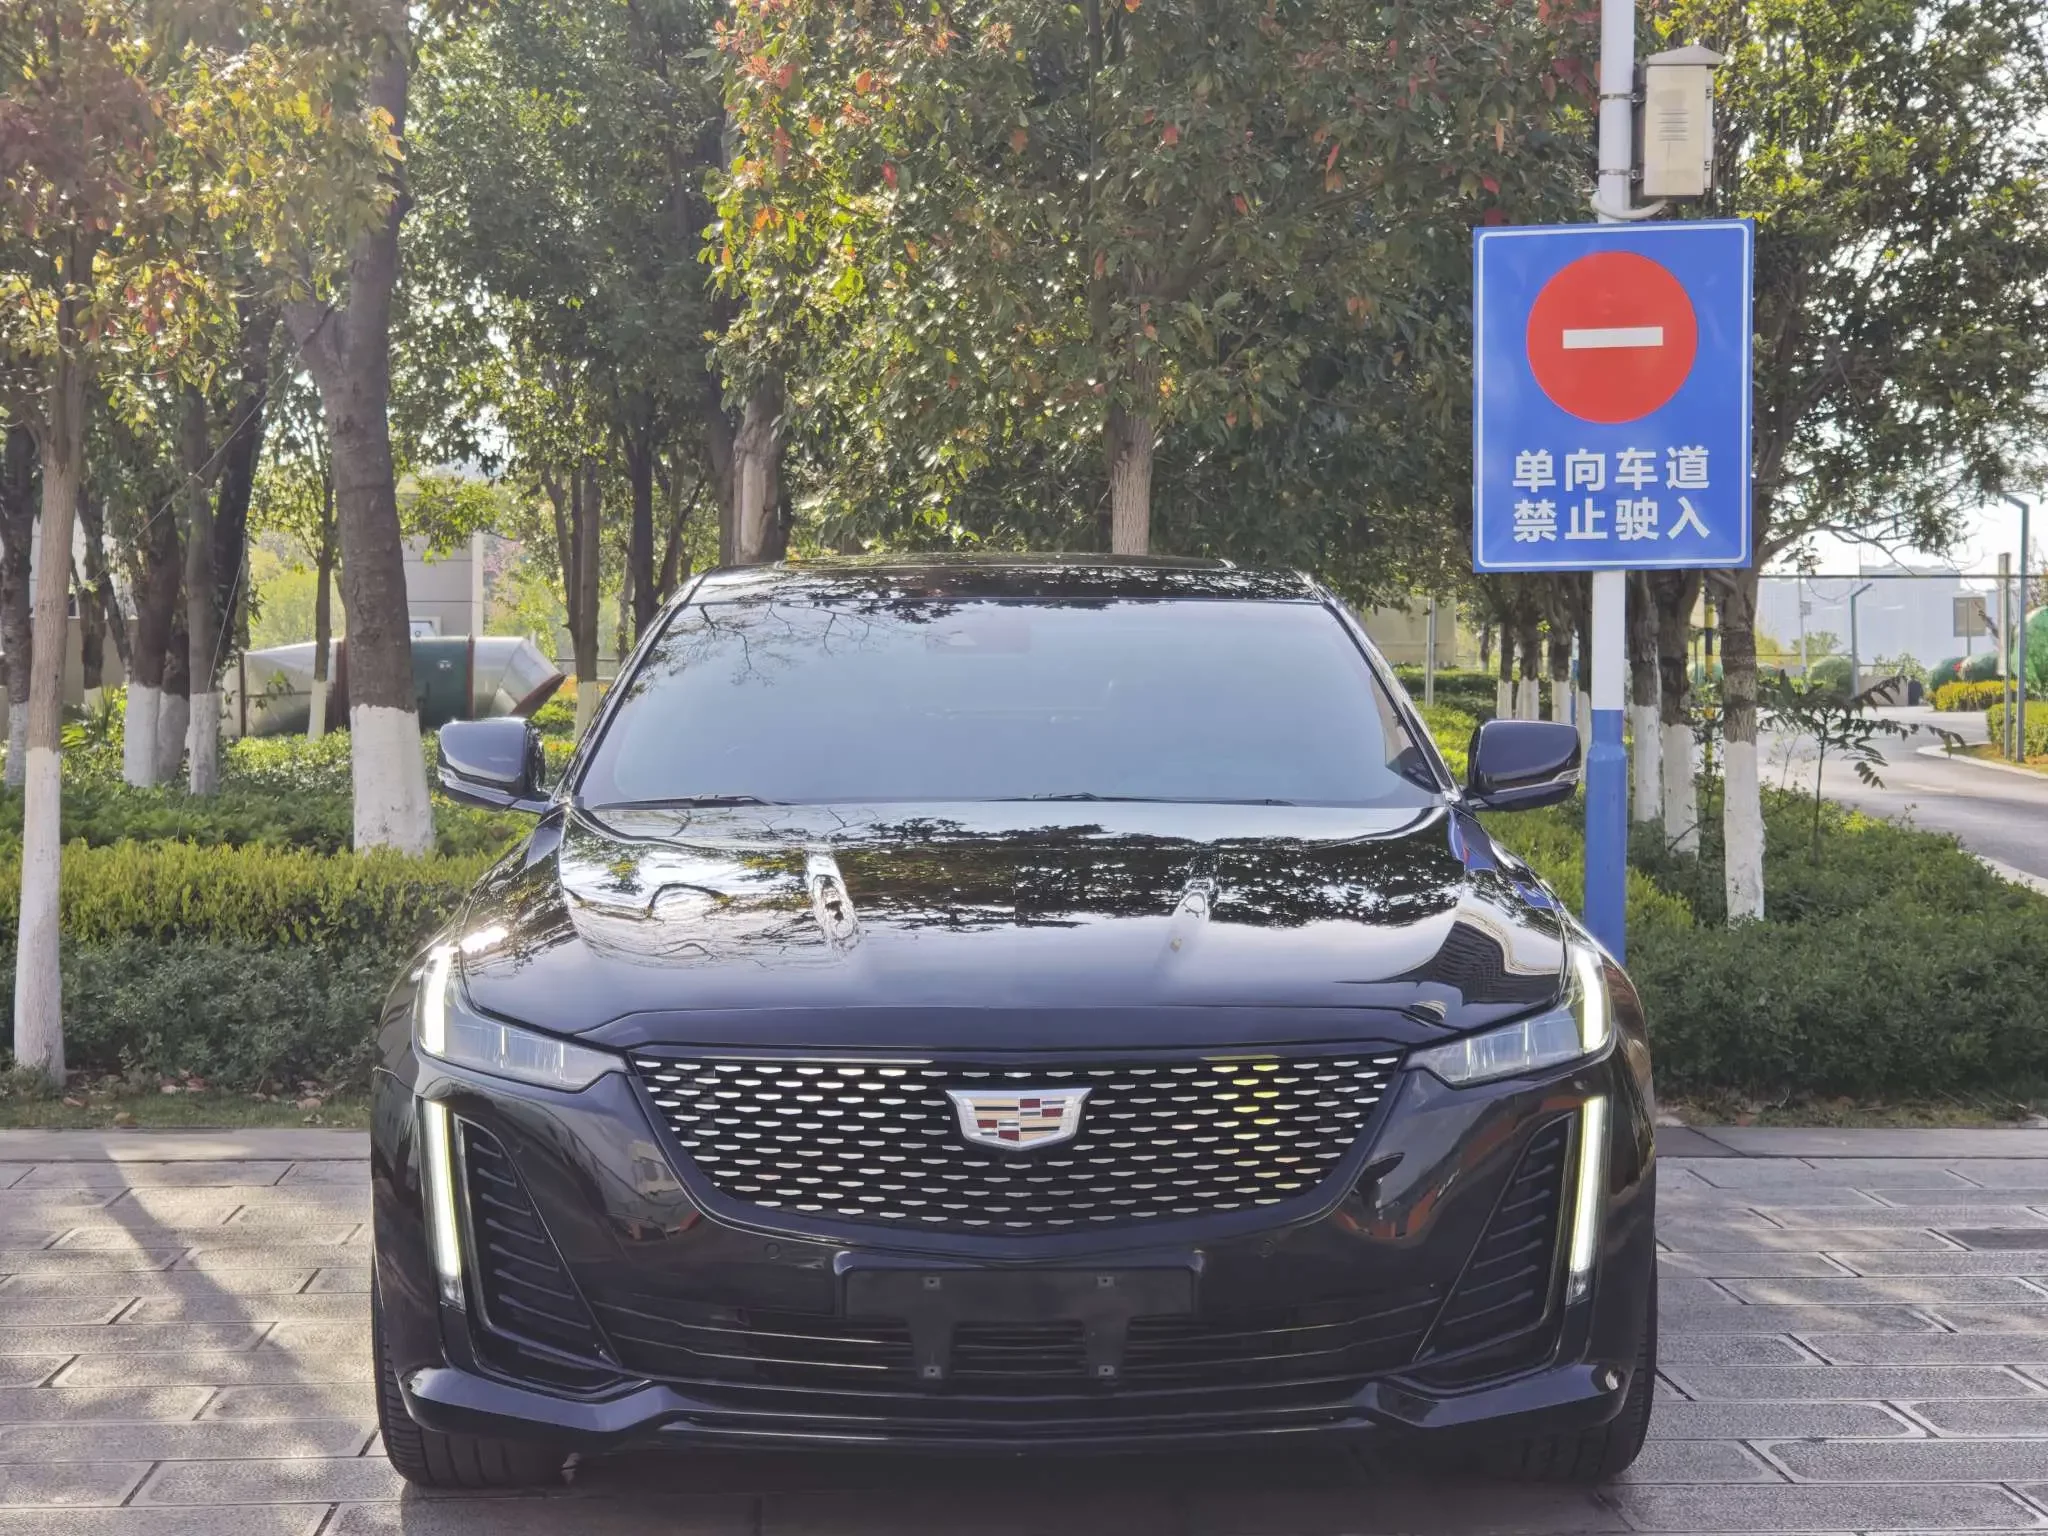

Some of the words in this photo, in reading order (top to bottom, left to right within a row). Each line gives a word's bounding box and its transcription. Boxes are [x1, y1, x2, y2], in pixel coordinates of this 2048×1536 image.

[1512, 445, 1710, 492] 单向车道
[1513, 496, 1711, 543] 禁止驶入
